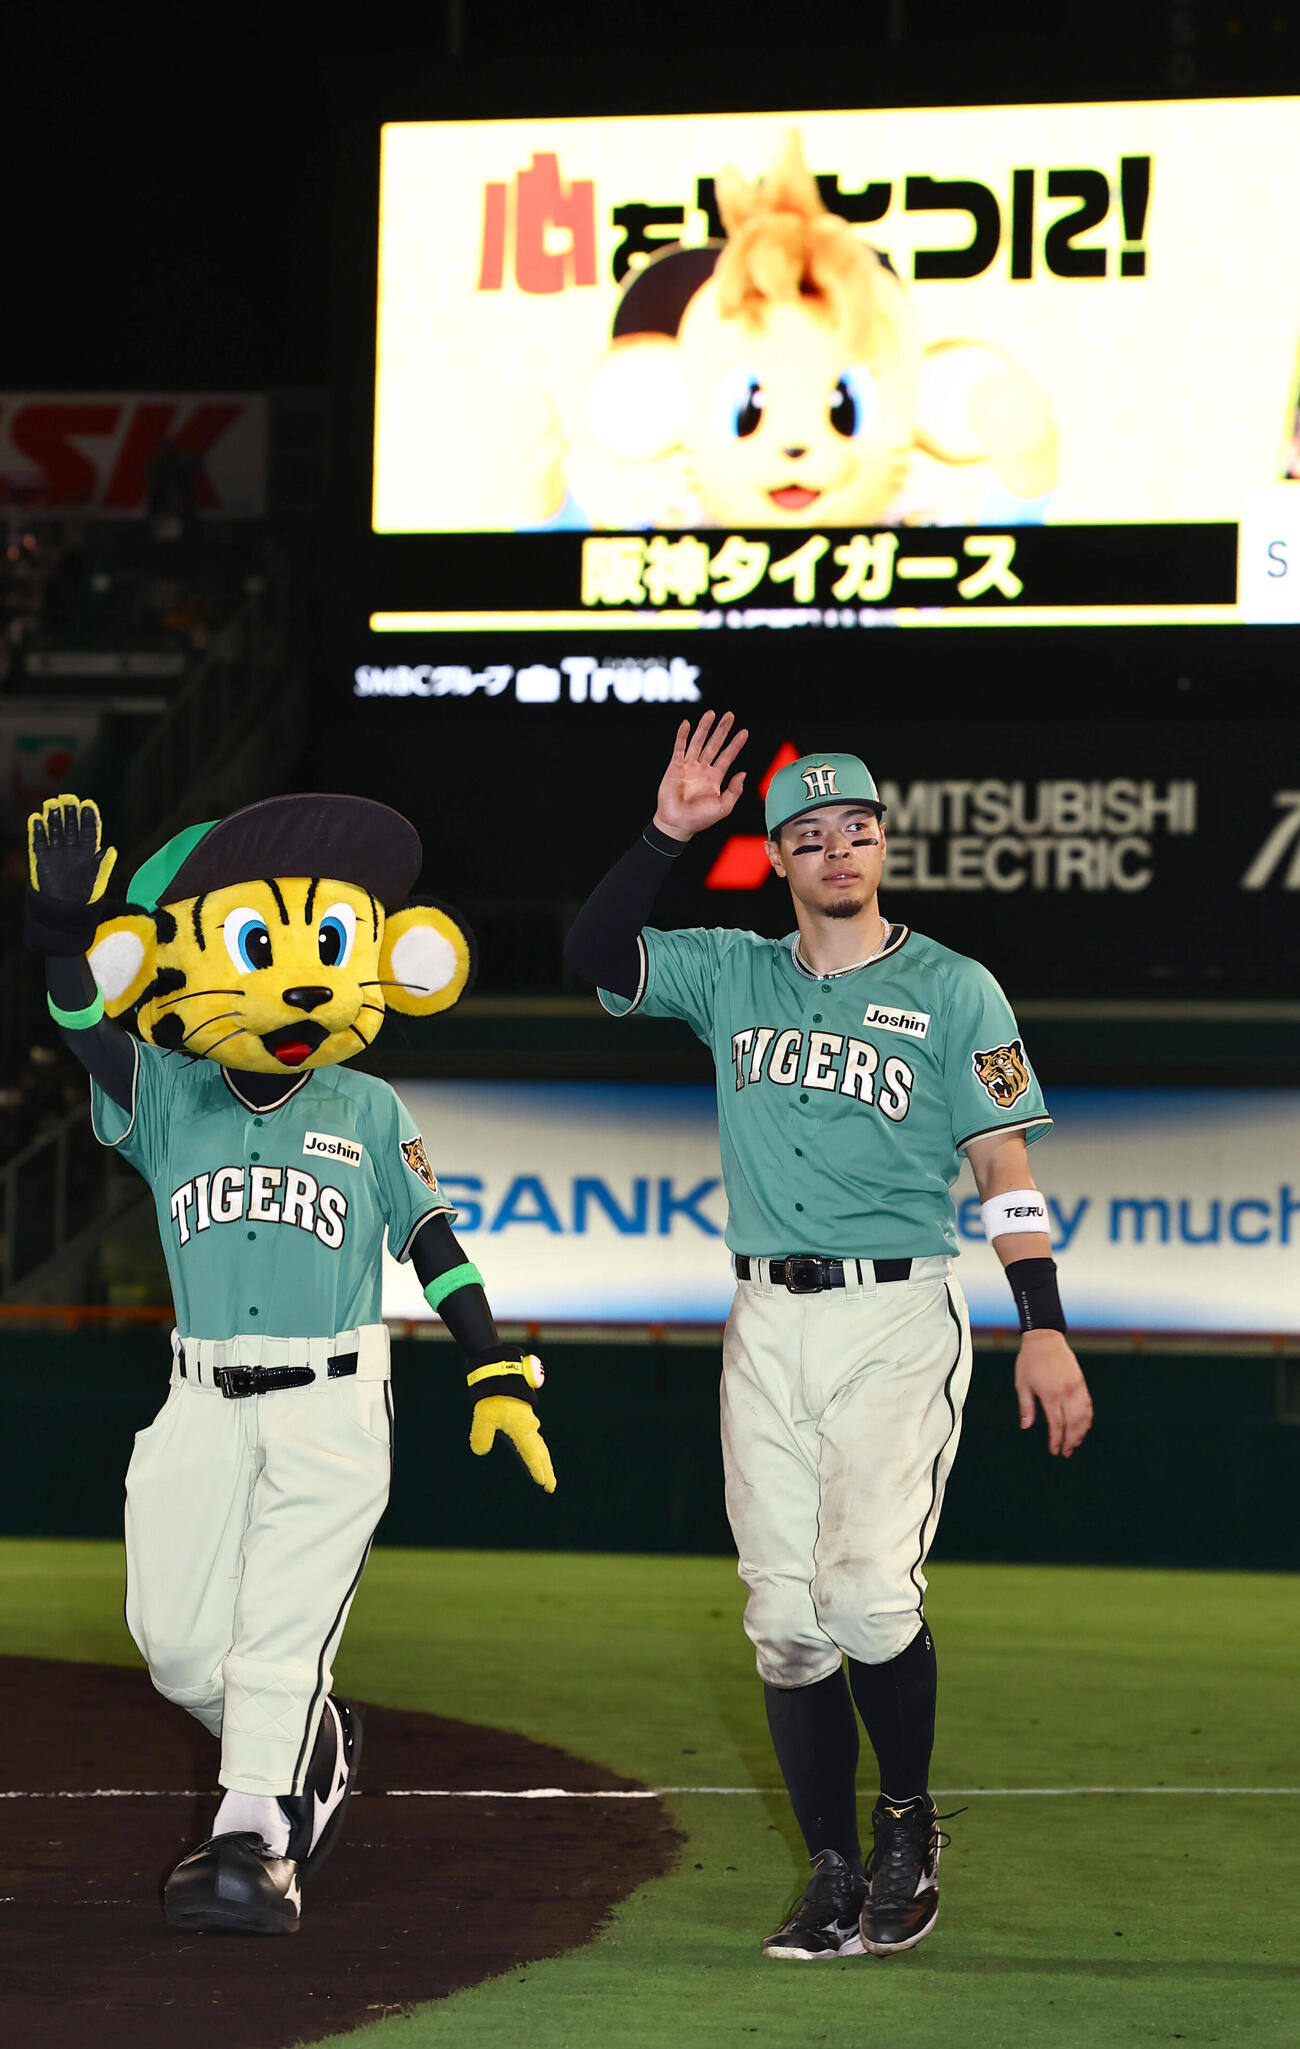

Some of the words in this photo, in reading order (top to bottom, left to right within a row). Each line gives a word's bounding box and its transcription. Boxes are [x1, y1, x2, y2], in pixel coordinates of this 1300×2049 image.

[0, 404, 245, 510] SK
[879, 780, 1197, 833] MITSUBISHI
[882, 836, 1153, 891] ELECTRIC
[866, 1009, 927, 1033] Joshin
[731, 1026, 915, 1123] TIGERS
[305, 1137, 360, 1162] Joshin
[170, 1165, 349, 1251] TIGERS
